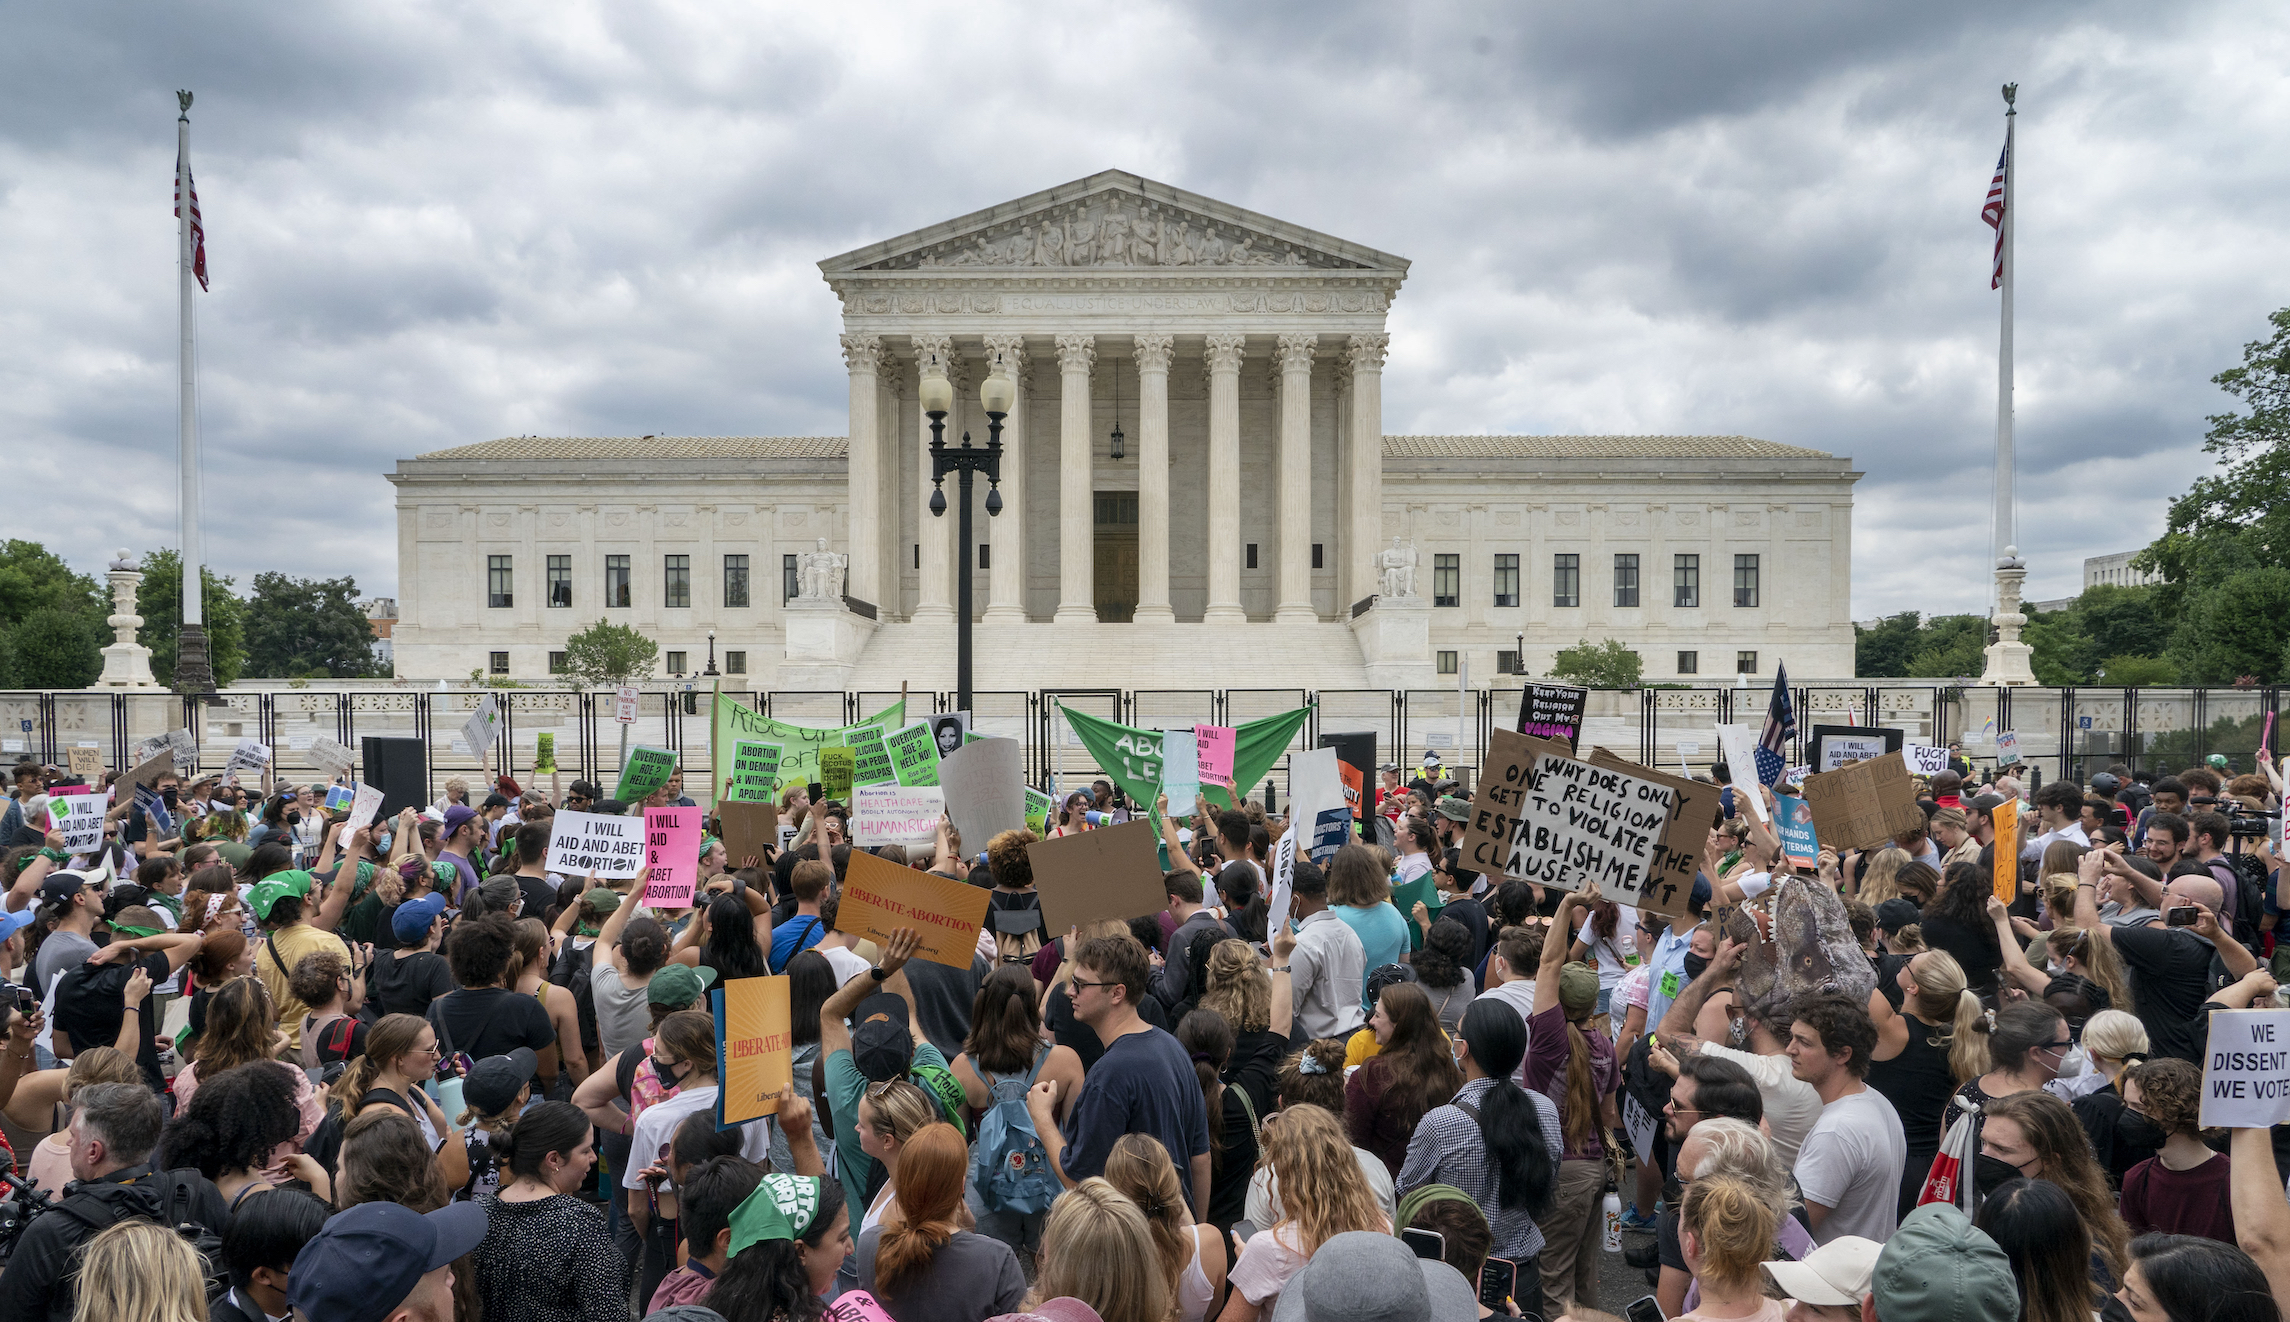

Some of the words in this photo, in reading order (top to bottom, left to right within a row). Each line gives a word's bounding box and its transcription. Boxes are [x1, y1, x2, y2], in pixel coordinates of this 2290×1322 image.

[1012, 298, 1063, 310] EQUAL
[1066, 298, 1125, 310] JUSTICE
[1132, 298, 1181, 310] UNDER
[1188, 298, 1217, 309] LAW
[619, 696, 636, 704] PARKING
[1532, 687, 1555, 698] KEEP
[1556, 689, 1579, 700] YOUR
[1533, 699, 1575, 711] RELIGION
[1532, 711, 1552, 722] OUT
[890, 725, 927, 748] OVERTURN
[1198, 729, 1201, 737] I
[1203, 729, 1219, 740] WILL
[1525, 722, 1573, 738] VAGINA
[855, 742, 884, 756] OLICITUD
[1197, 740, 1209, 749] AID
[1843, 742, 1846, 750] I
[1848, 742, 1865, 750] WILL
[635, 750, 673, 766] OVERTURN
[742, 745, 778, 759] ABORTION
[1829, 750, 1841, 759] AID
[1843, 751, 1858, 759] AND
[1859, 751, 1878, 759] ABET
[1914, 747, 1946, 759] FUCK
[735, 760, 747, 770] ON
[749, 761, 778, 773] DEMAND
[823, 759, 852, 767] SCOTUS
[856, 759, 868, 769] SIN
[900, 756, 918, 770] HELL
[920, 749, 932, 761] NO!
[1197, 761, 1213, 771] ABET
[75, 763, 92, 771] DIE
[907, 770, 919, 779] Rise
[920, 768, 927, 776] Up
[629, 774, 647, 786] HELL
[648, 777, 662, 787] NO!
[736, 776, 742, 784] &
[745, 775, 774, 787] WITHOUT
[1344, 774, 1352, 785] THE
[1810, 767, 1872, 801] SUPREME
[738, 788, 769, 800] APOLOGY
[1544, 758, 1585, 783] WHY
[1588, 769, 1632, 798] DOES
[1638, 785, 1690, 821] ONLY
[1505, 764, 1550, 792] ONE
[1562, 783, 1662, 830] RELIGION
[1851, 800, 1863, 813] IS
[1869, 794, 1877, 805] A
[72, 803, 74, 815] I
[76, 802, 93, 815] WILL
[72, 818, 86, 831] AND
[87, 817, 103, 830] ABET
[650, 815, 653, 828] I
[656, 815, 680, 828] WILL
[861, 820, 907, 835] HUMAN
[1315, 821, 1342, 835] DOCTORS
[1820, 814, 1879, 848] SUPREME
[1878, 803, 1921, 835] FAILURE
[585, 821, 590, 834] I
[595, 822, 624, 837] WILL
[1490, 785, 1524, 806] GET
[1532, 796, 1560, 815] TO
[1570, 805, 1648, 858] VIOLATE
[1653, 844, 1693, 875] THE
[1785, 828, 1810, 840] HANDS
[64, 833, 99, 848] BORTION
[556, 836, 579, 850] AID
[581, 839, 609, 853] AND
[612, 841, 645, 855] ABET
[650, 833, 667, 846] AID
[1313, 835, 1324, 847] NOT
[1312, 844, 1340, 859] DOCTRINE
[1786, 841, 1814, 853] TERMS
[559, 853, 636, 871] ABORTION
[651, 850, 659, 864] &
[1476, 810, 1677, 905] ESTABLISHMENT
[649, 868, 673, 881] ABET
[645, 885, 691, 899] ABORTION
[850, 886, 905, 915] LIBERATE
[907, 907, 975, 933] ABORTION
[2251, 1024, 2275, 1043] WE
[733, 1034, 781, 1058] LIBERATE
[2213, 1052, 2287, 1071] DISSENT
[2213, 1080, 2246, 1099] WE
